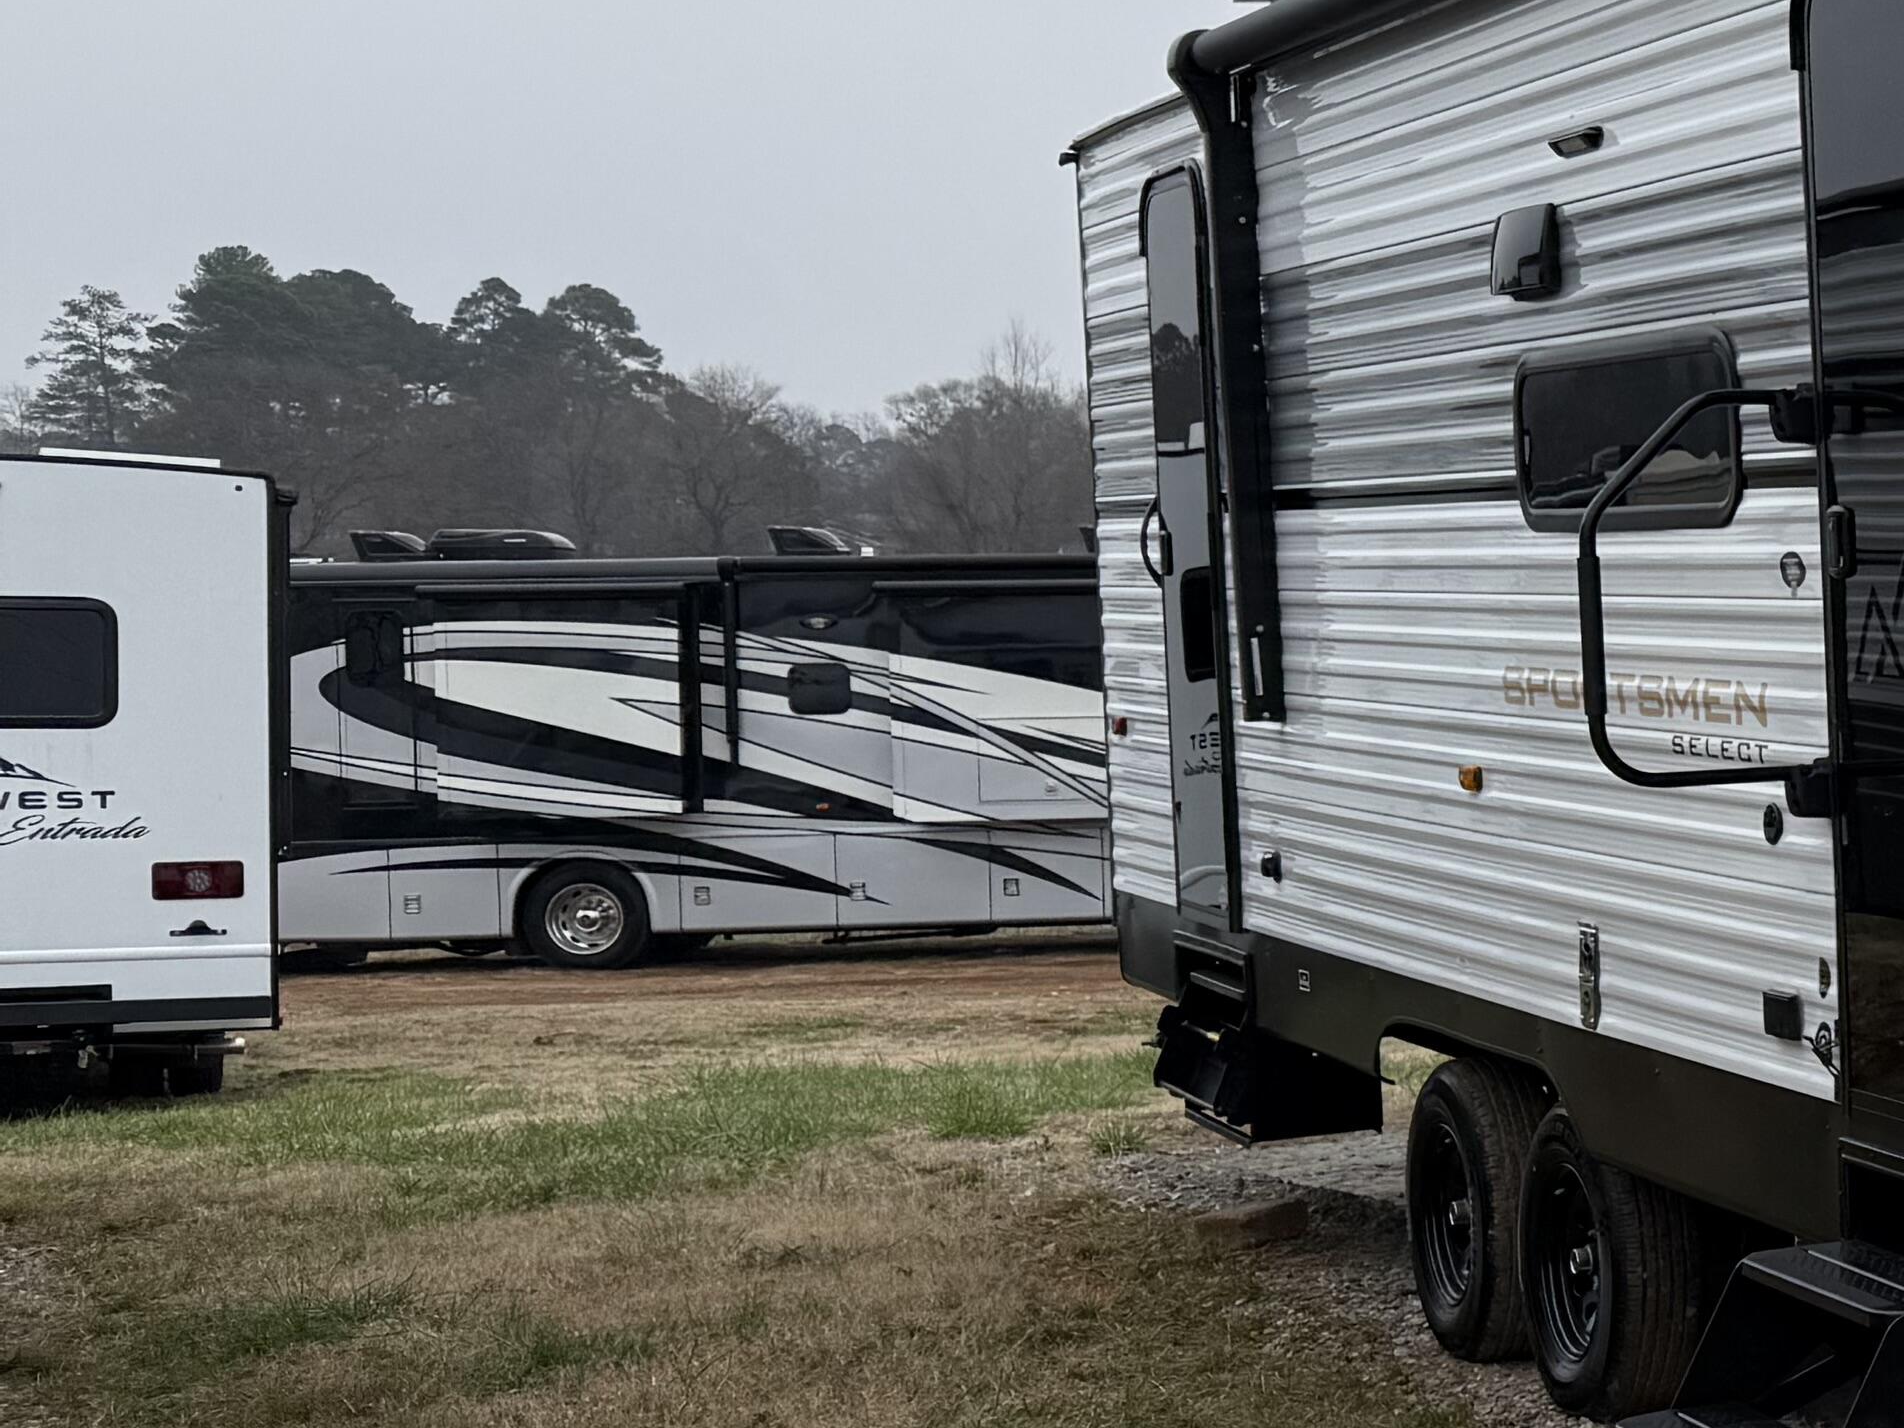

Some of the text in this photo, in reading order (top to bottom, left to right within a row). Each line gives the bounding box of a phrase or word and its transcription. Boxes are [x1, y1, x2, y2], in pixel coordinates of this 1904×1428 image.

[1502, 665, 1769, 728] SPOTSMEN
[1671, 735, 1770, 765] SELECT
[0, 790, 116, 810] EST
[0, 814, 151, 846] Entrada
